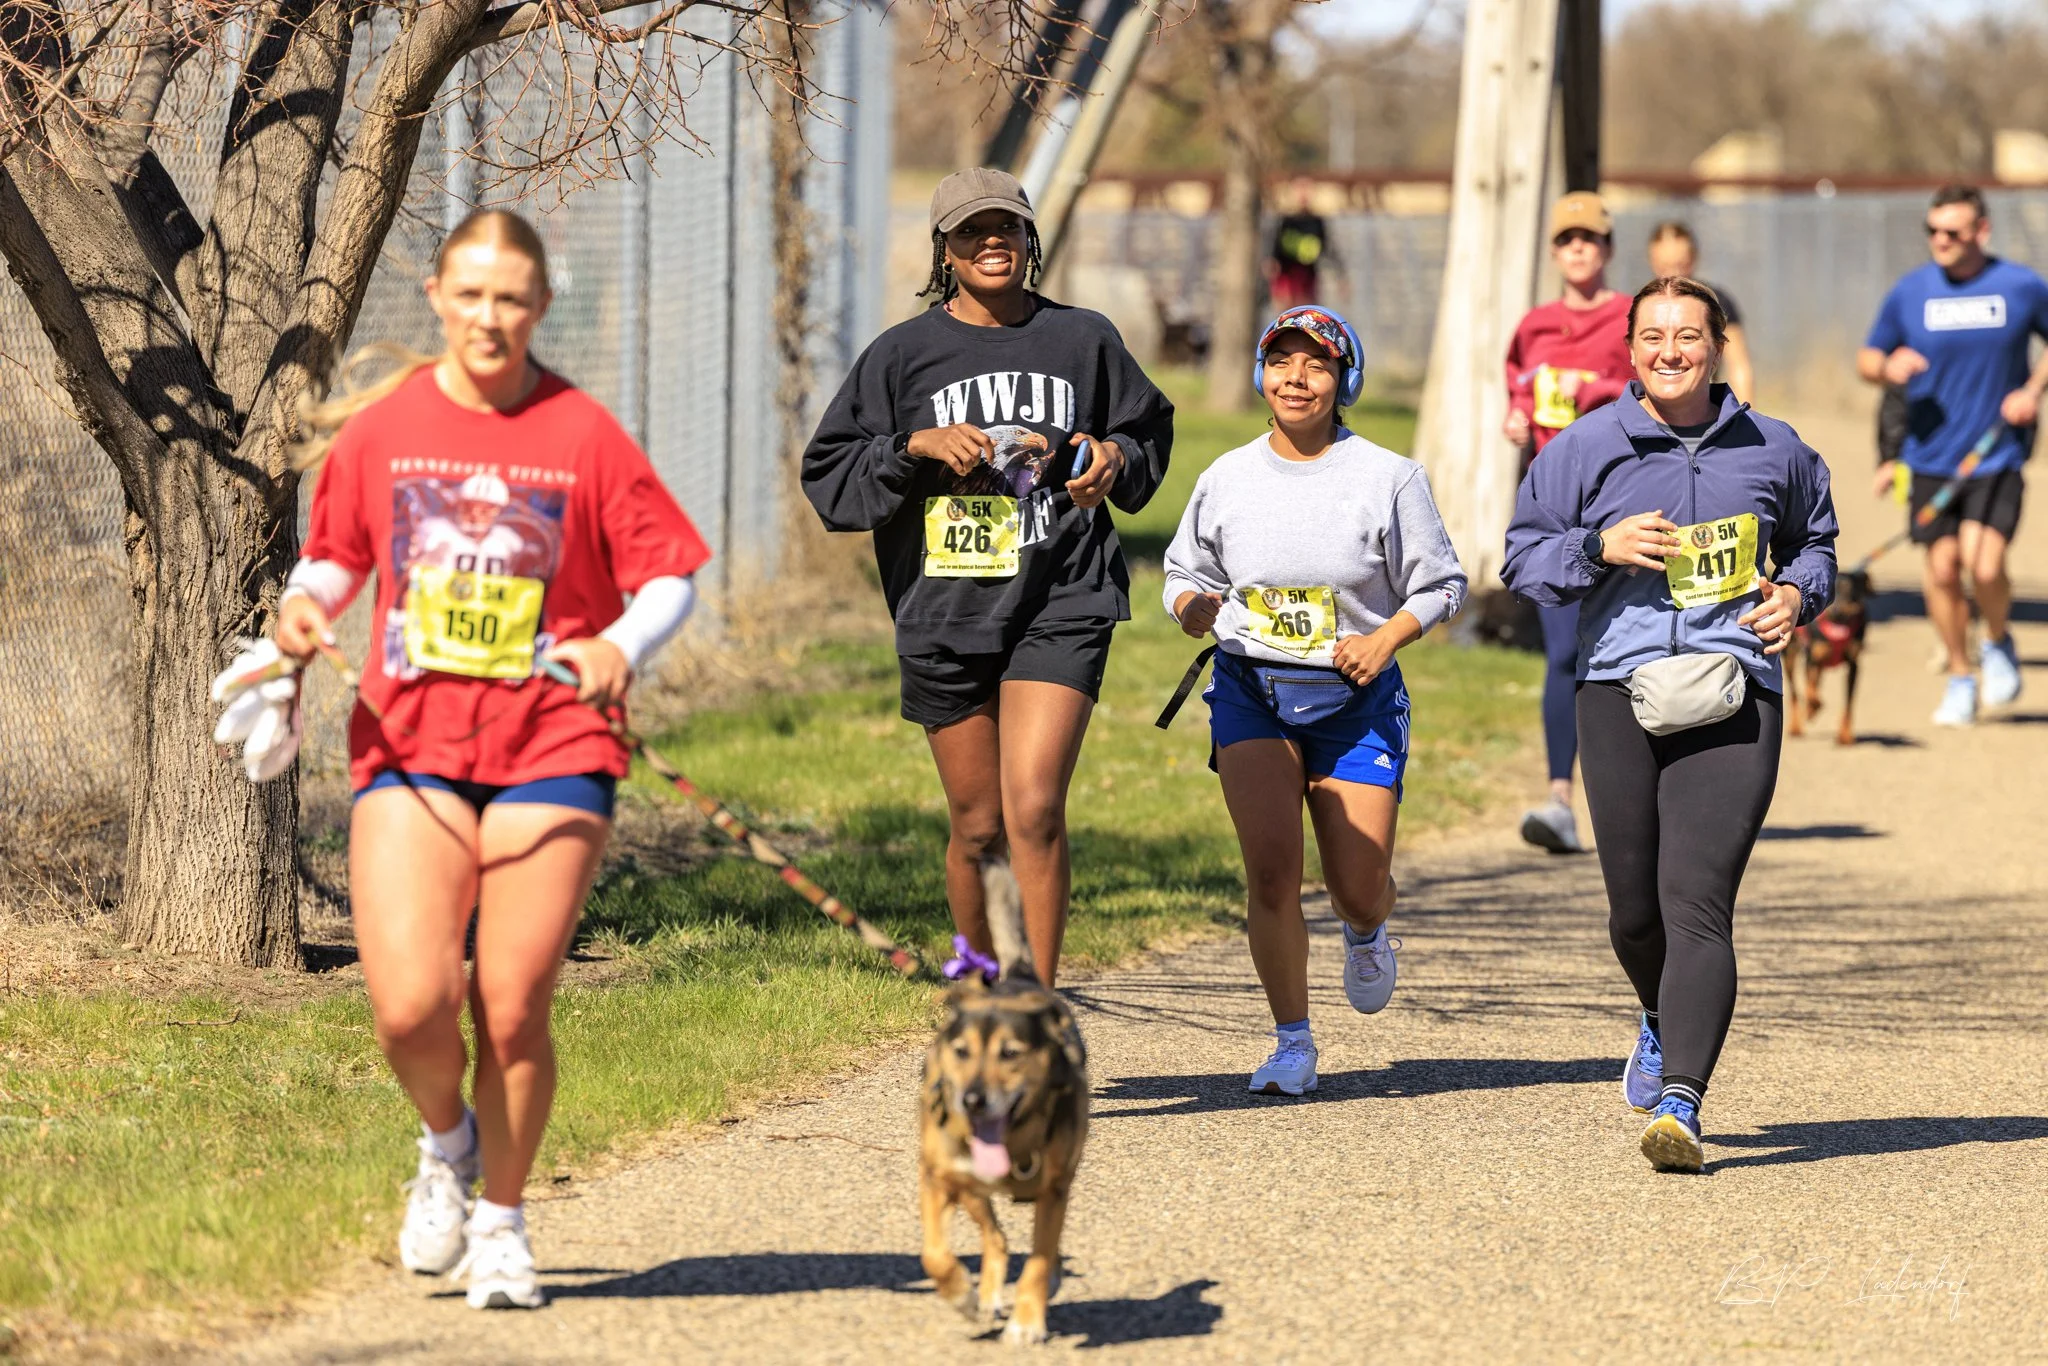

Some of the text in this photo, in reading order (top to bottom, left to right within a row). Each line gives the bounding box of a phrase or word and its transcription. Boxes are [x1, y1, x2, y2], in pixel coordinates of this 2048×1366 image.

[931, 371, 1076, 432] WWJD
[972, 501, 992, 518] 5K
[944, 525, 992, 554] 426
[1717, 521, 1739, 541] 5K
[1696, 547, 1737, 580] 417
[1287, 589, 1309, 604] 5K
[446, 609, 498, 644] 150
[1268, 610, 1313, 638] 266
